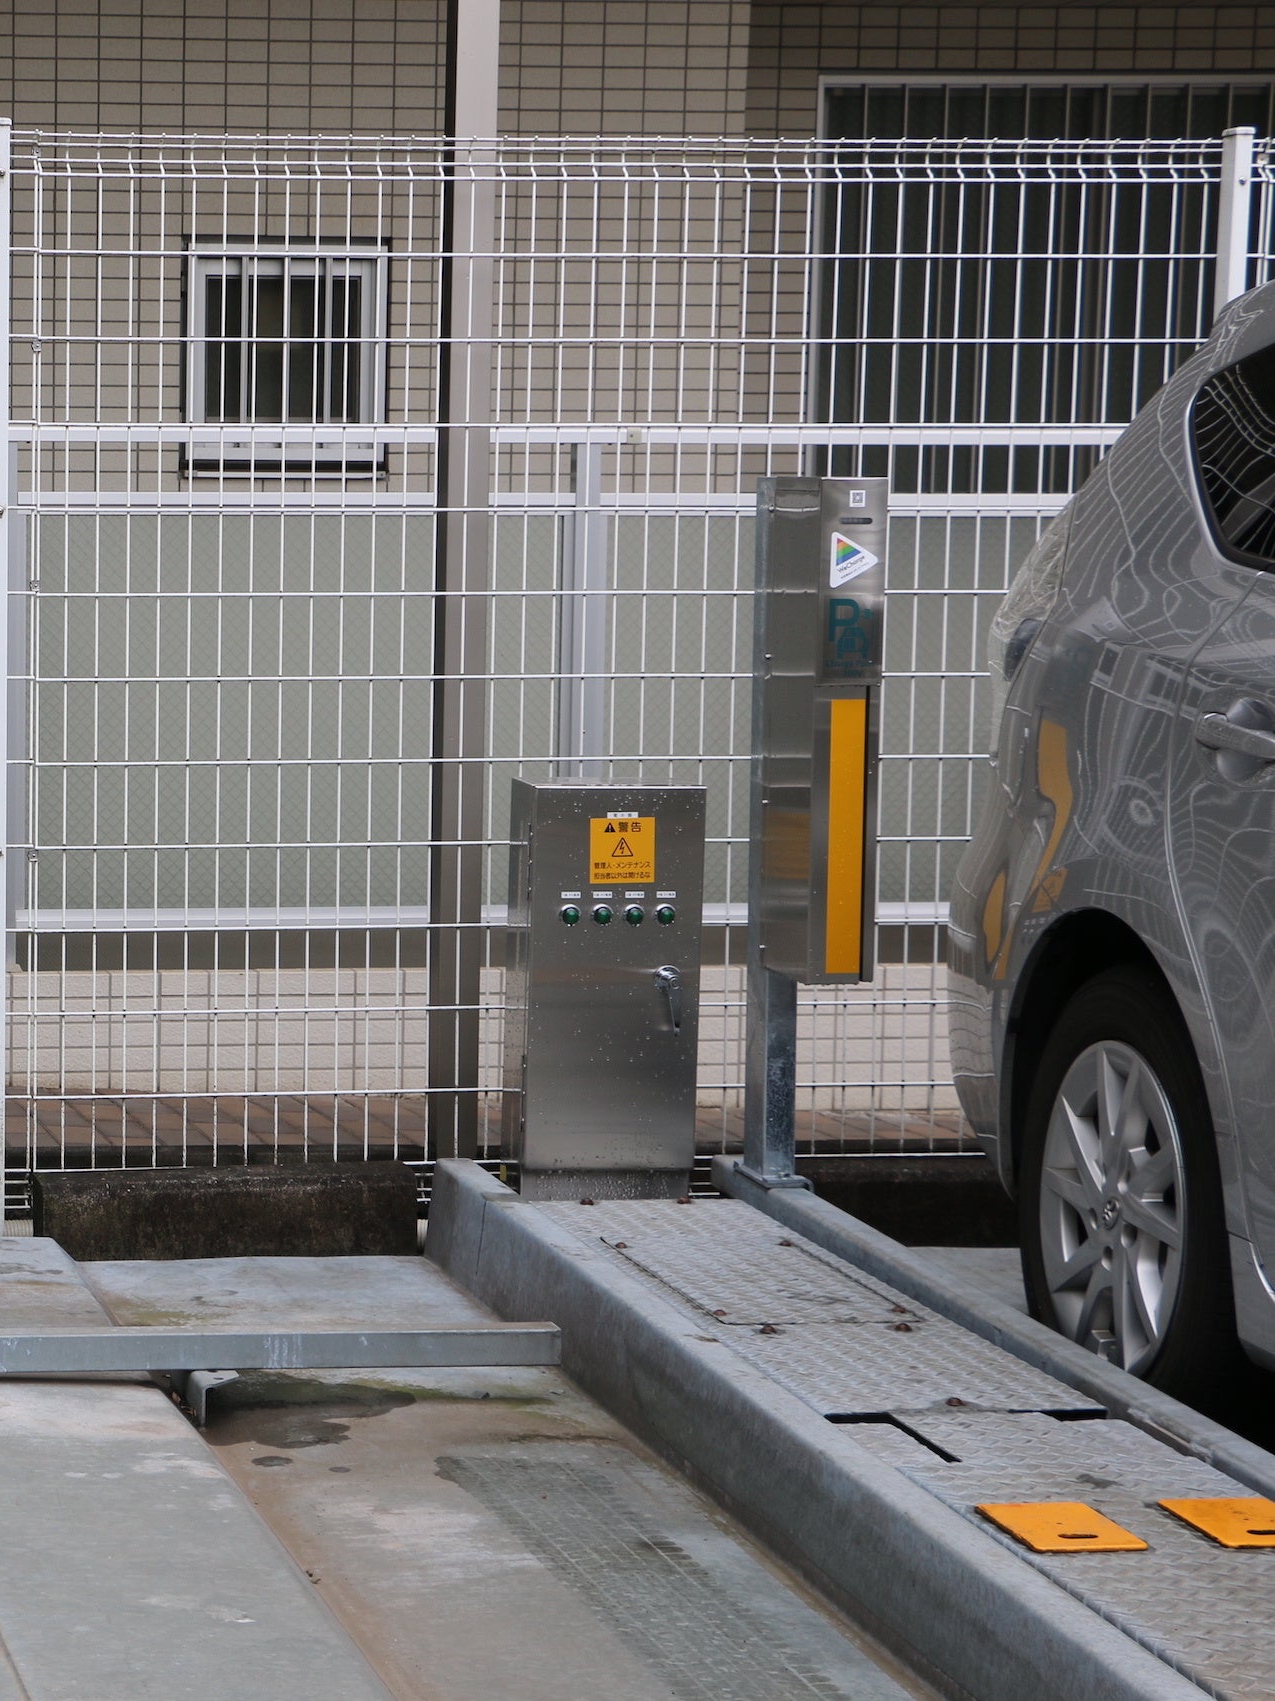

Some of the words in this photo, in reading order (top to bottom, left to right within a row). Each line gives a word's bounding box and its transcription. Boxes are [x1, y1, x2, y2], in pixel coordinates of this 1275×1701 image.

[837, 555, 865, 573] WeCharge
[829, 598, 860, 642] P
[618, 821, 641, 833] 警告
[594, 871, 651, 880] 担当者以外は開けるな
